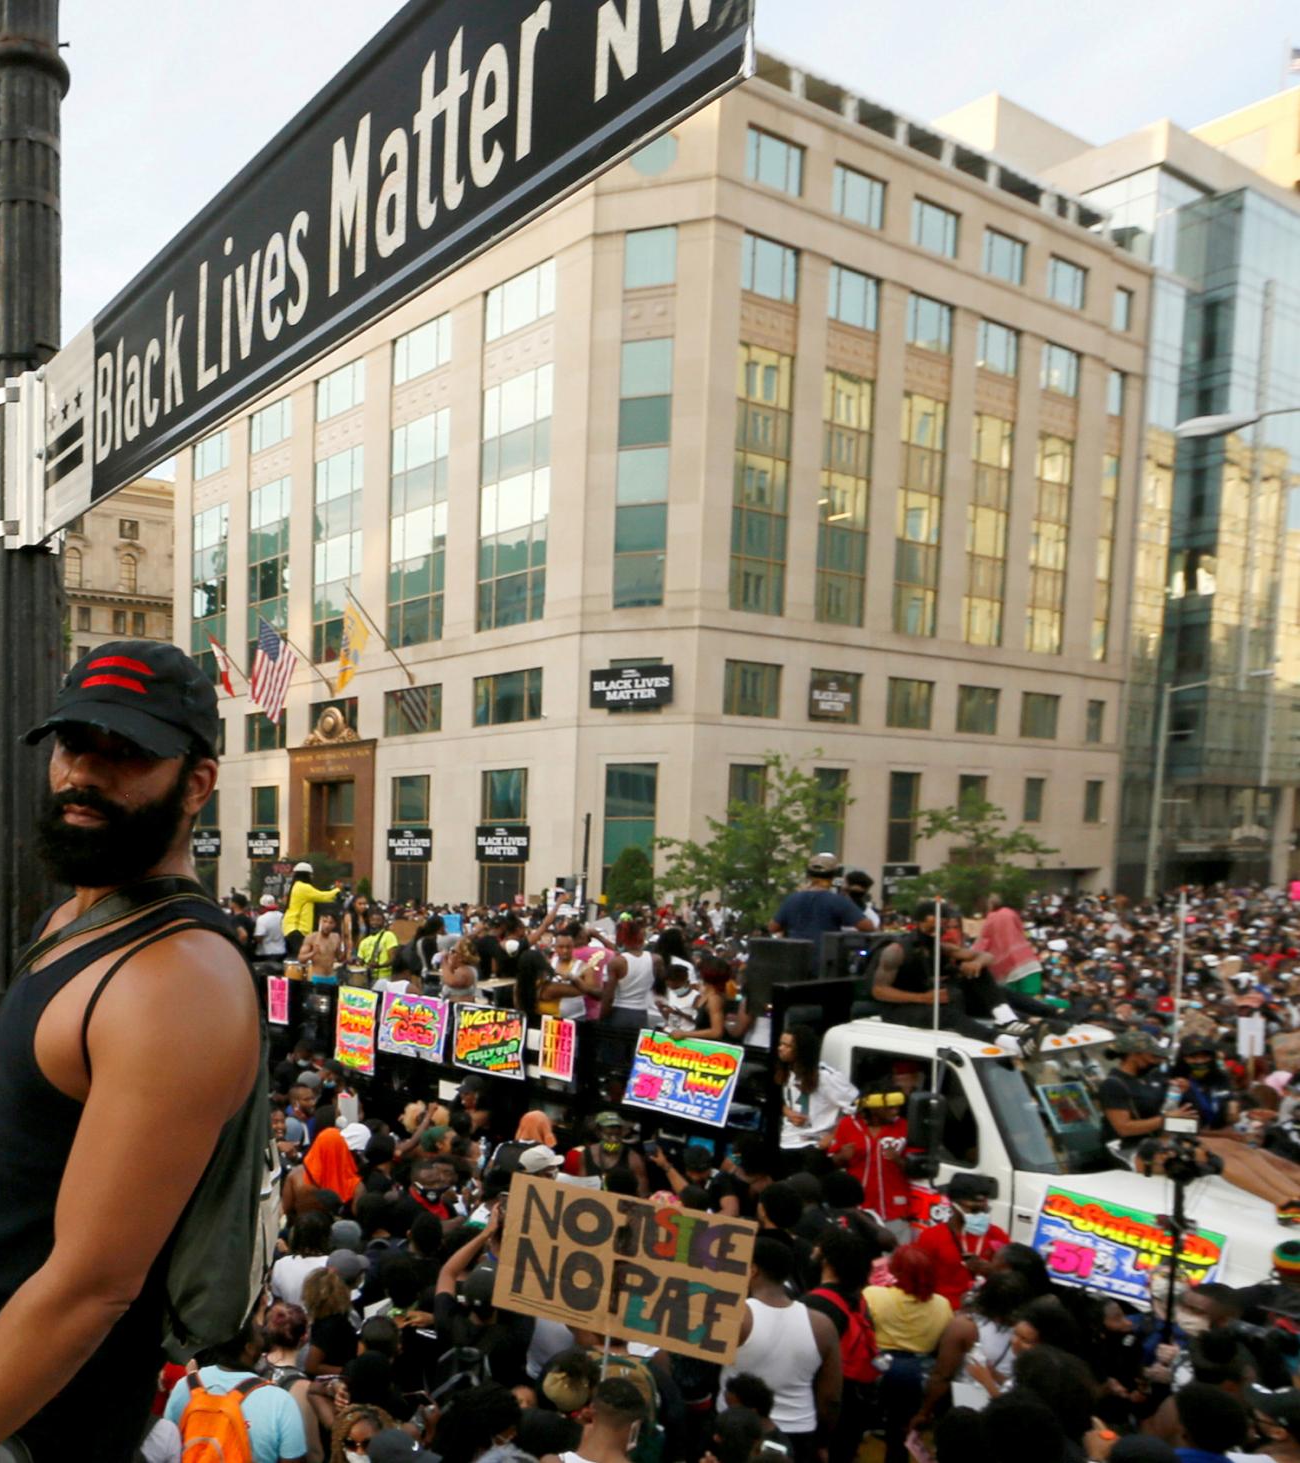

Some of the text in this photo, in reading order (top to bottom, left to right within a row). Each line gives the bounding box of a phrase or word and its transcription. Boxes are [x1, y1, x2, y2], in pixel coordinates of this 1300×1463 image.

[96, 290, 185, 465] Black
[197, 211, 309, 392] Lives
[328, 0, 551, 298] Matter
[593, 676, 670, 691] BLACK LIVES
[605, 688, 657, 701] MATTER
[388, 838, 430, 847] BLACK LIVES
[477, 836, 528, 846] BLACK LIVES
[395, 846, 424, 856] MATTER
[484, 846, 519, 856] MATTER
[521, 1184, 754, 1276] NO JUSTICE
[511, 1236, 740, 1354] NO PEACE
